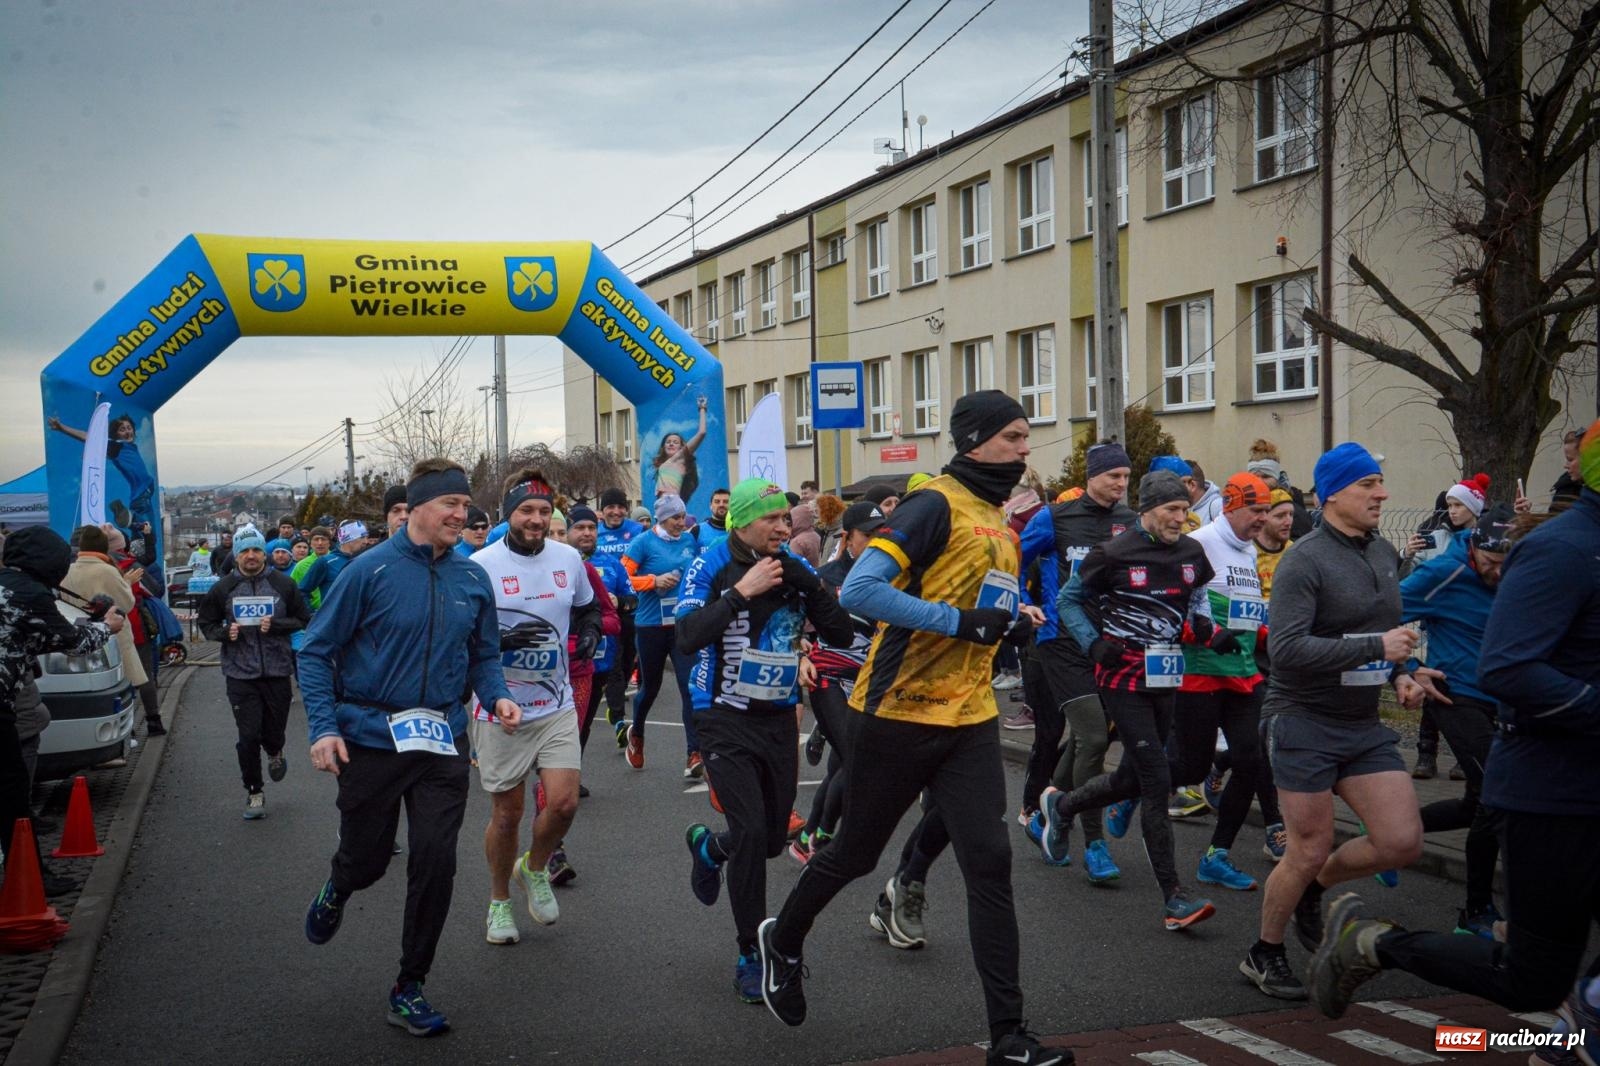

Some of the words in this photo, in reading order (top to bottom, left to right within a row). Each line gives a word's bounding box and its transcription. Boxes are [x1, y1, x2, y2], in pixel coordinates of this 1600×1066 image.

[355, 254, 458, 271] Gmina
[329, 274, 488, 295] Pietrowice
[350, 298, 467, 317] Wielkie
[89, 319, 158, 376] Gmina
[149, 271, 206, 323] ludzi
[596, 278, 650, 332] Gmina
[648, 326, 696, 371] ludzi
[118, 298, 226, 396] aktywnych
[580, 300, 676, 388] aktywnych
[240, 604, 267, 617] 230
[1239, 602, 1262, 620] 122
[511, 650, 551, 670] 209
[1162, 656, 1178, 674] 91
[756, 664, 784, 686] 52
[405, 719, 444, 741] 150
